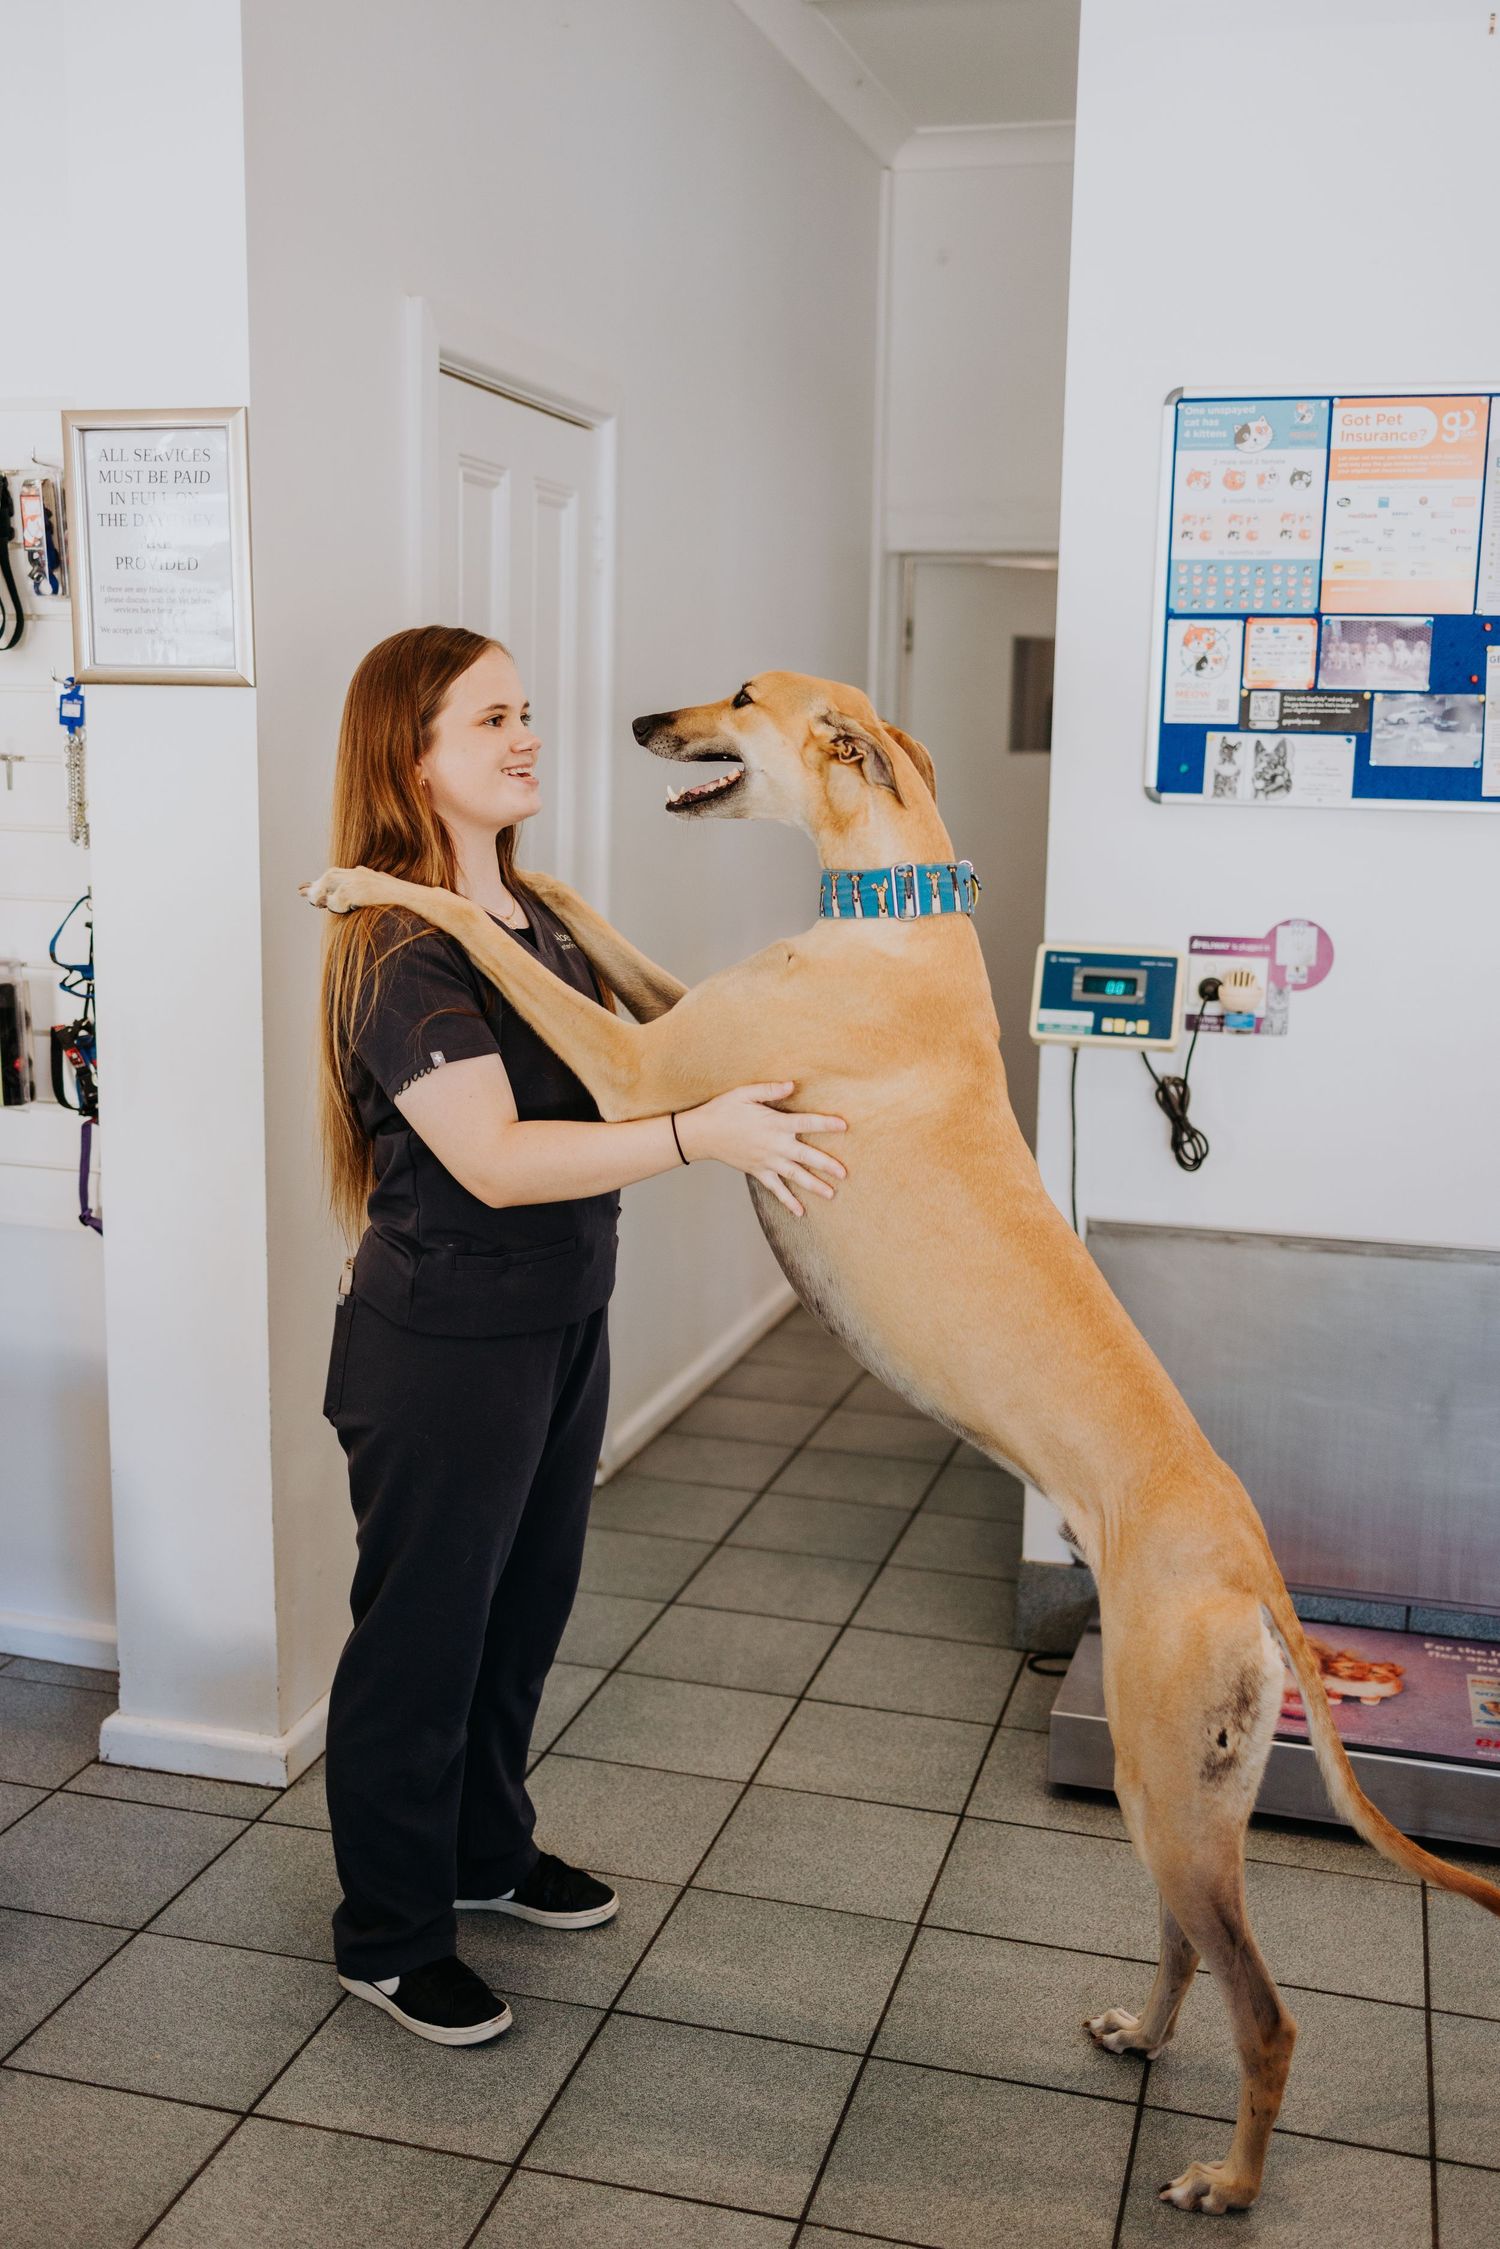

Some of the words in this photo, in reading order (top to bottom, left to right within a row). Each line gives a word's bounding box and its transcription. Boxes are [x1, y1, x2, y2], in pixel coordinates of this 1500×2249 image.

[1341, 413, 1371, 426] Got
[1375, 412, 1403, 425] Pet
[1340, 428, 1428, 443] Insurance?
[98, 448, 129, 462] ALL
[133, 448, 211, 463] SERVICES
[98, 470, 144, 484] MUST
[147, 470, 169, 484] BE
[173, 470, 211, 484] PAID
[109, 491, 126, 506] IN
[97, 513, 129, 527] THE
[114, 556, 199, 571] PROVIDED
[1424, 1642, 1454, 1652] For
